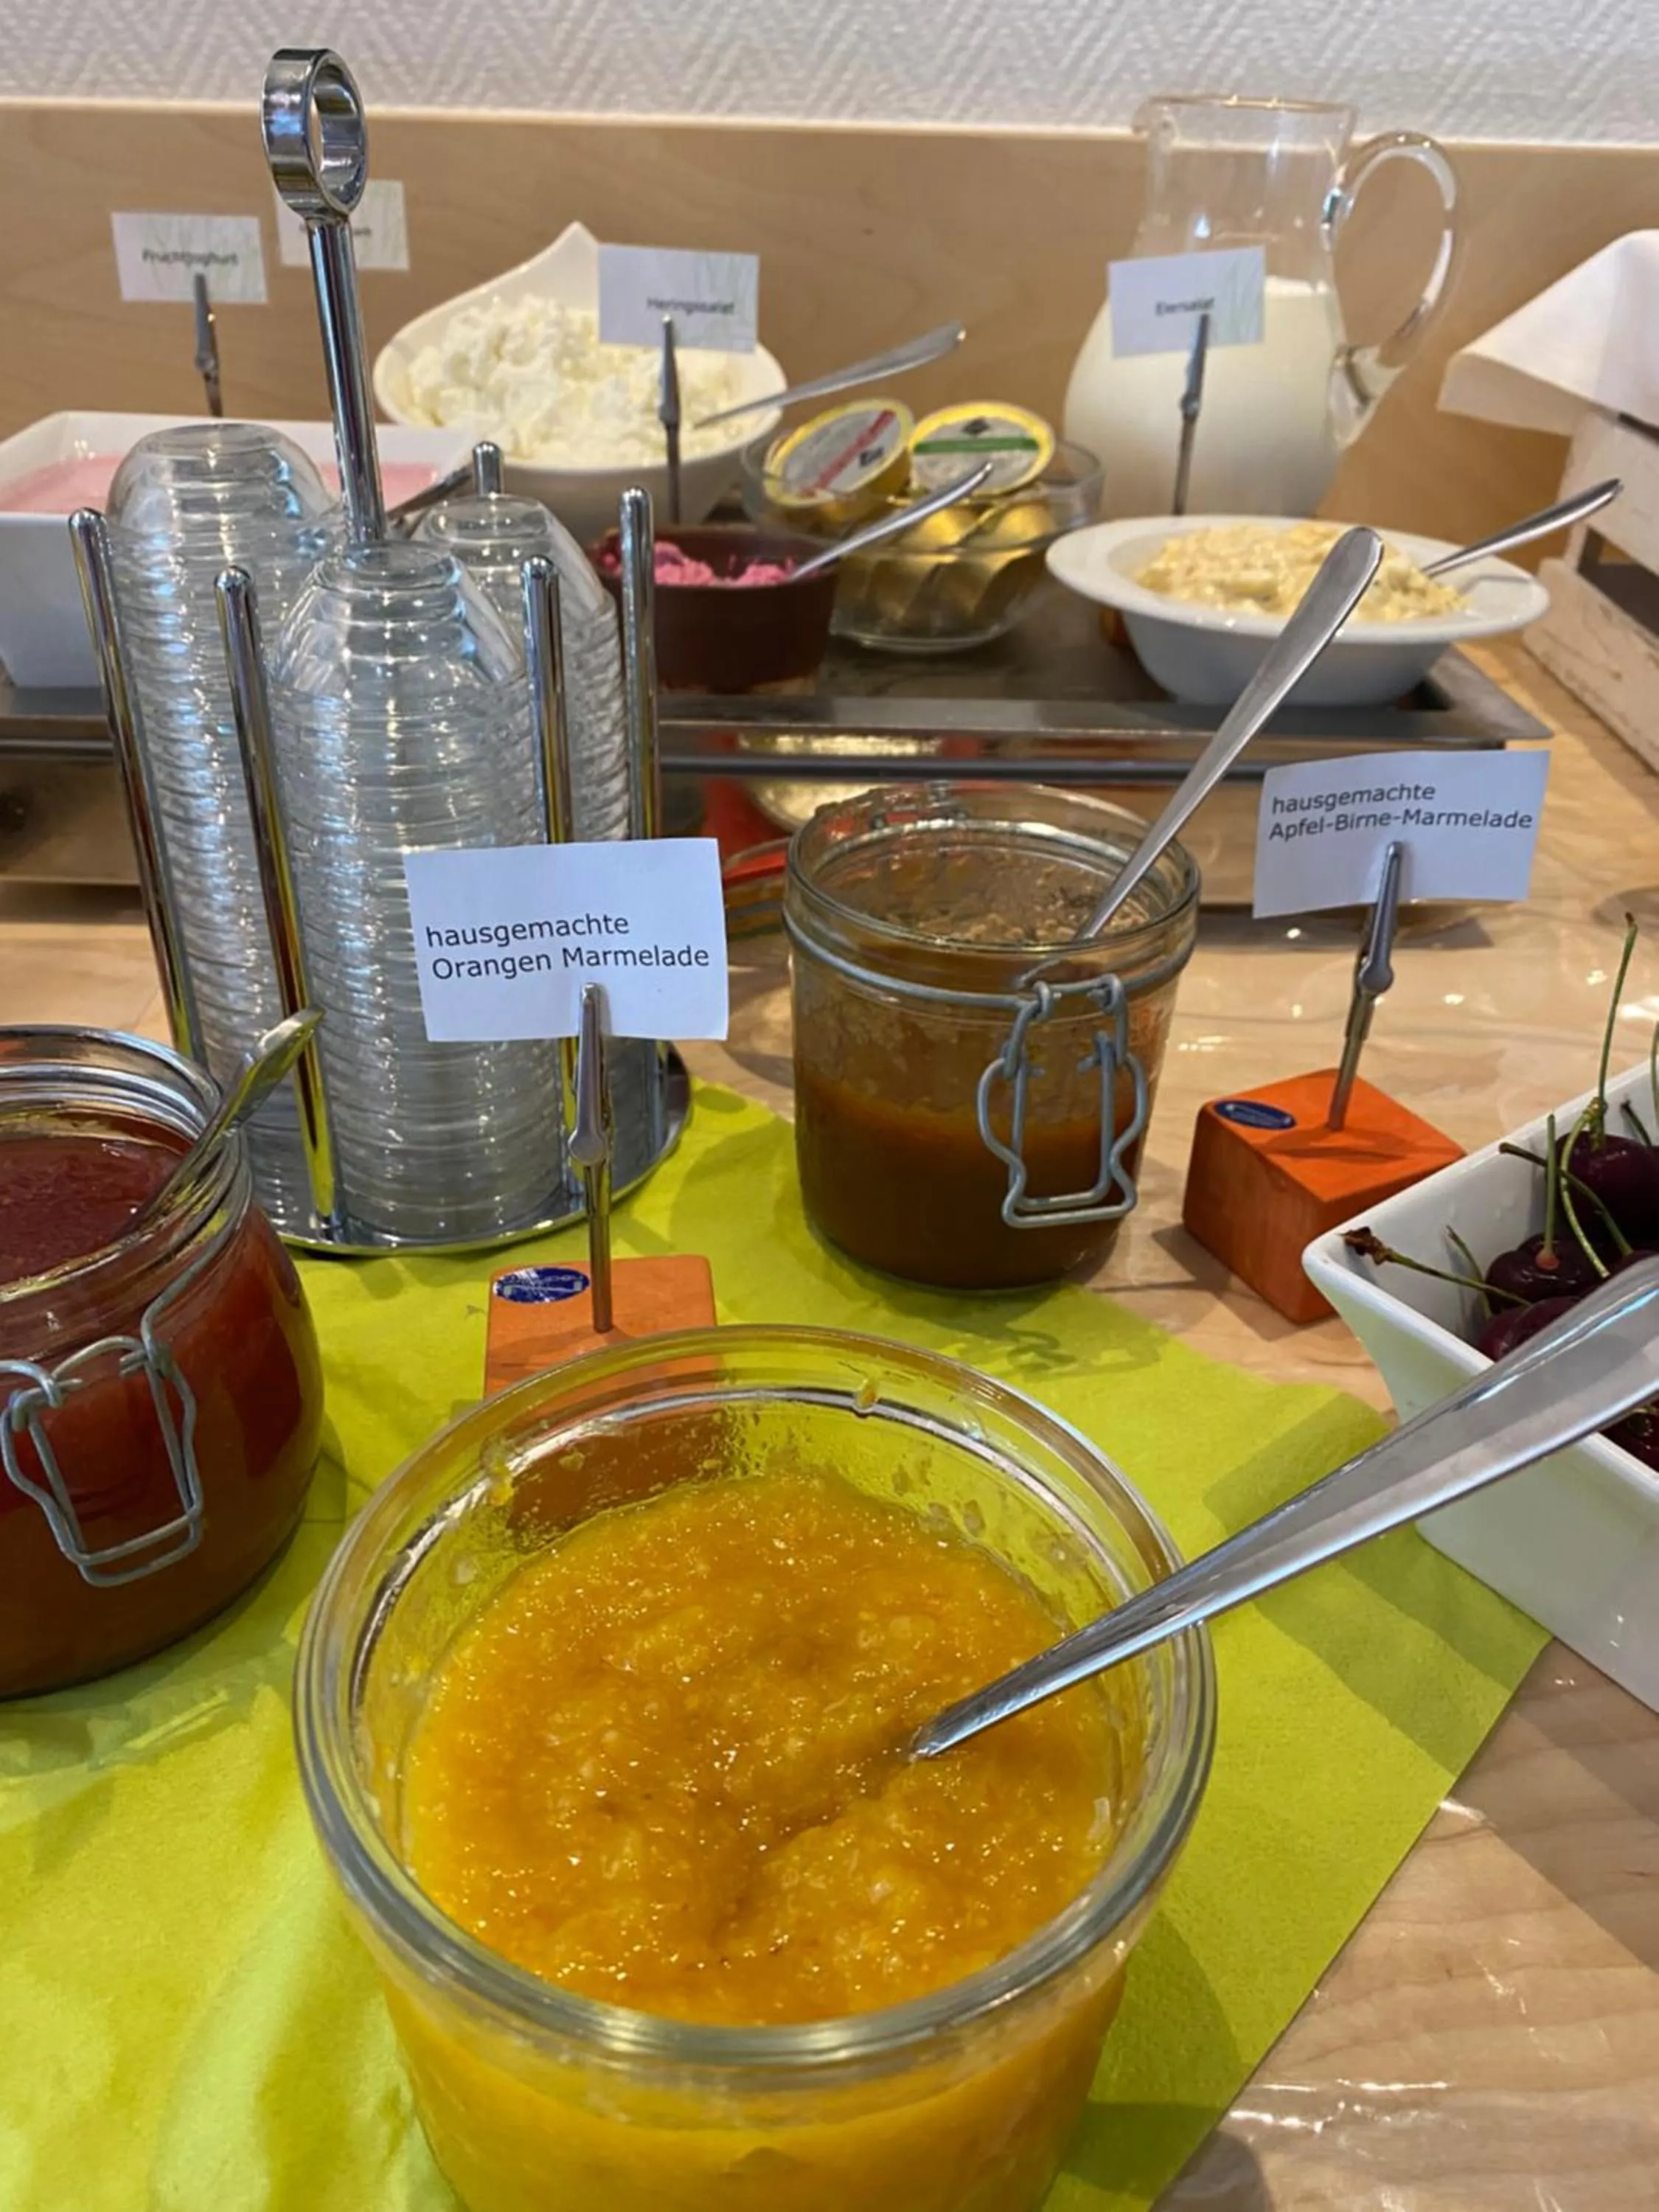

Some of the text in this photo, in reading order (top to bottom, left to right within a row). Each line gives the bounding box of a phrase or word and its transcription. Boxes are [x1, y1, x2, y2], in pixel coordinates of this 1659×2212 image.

[1271, 783, 1436, 815] hausgemachte
[1268, 808, 1534, 841] Apfel-Birne-Marmelade
[425, 913, 630, 948] hausgemachte
[432, 944, 709, 980] Orangen Marmelade
